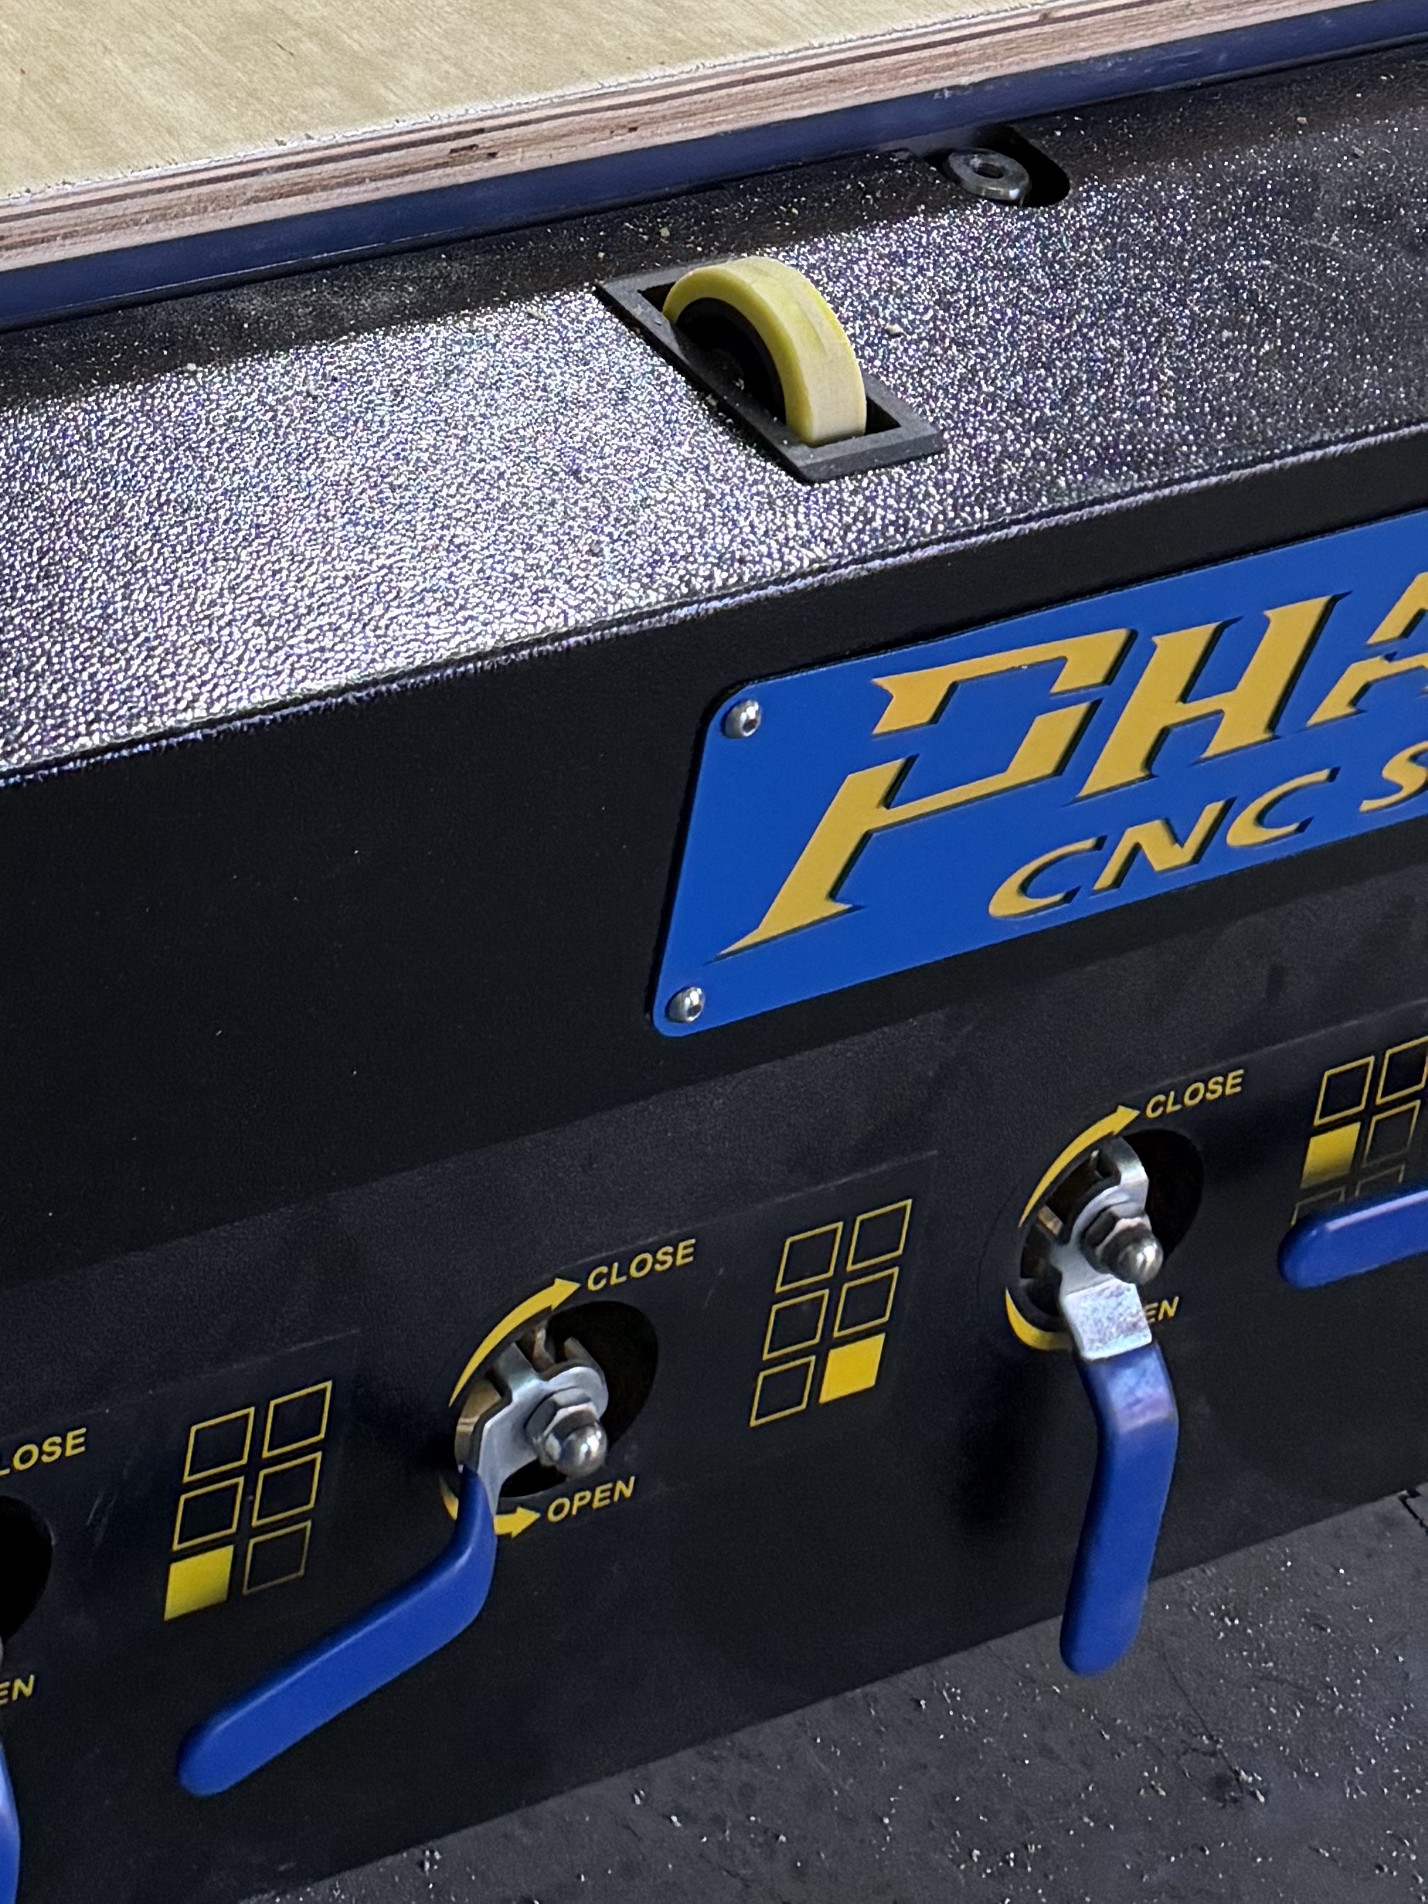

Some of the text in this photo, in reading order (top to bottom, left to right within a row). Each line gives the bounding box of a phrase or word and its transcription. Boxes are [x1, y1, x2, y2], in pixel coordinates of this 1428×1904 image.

[987, 767, 1336, 919] CNC
[1146, 1069, 1244, 1119] CLOSE
[587, 1239, 696, 1291] CLOSE
[1145, 1296, 1179, 1324] EN
[547, 1476, 635, 1522] OPEN
